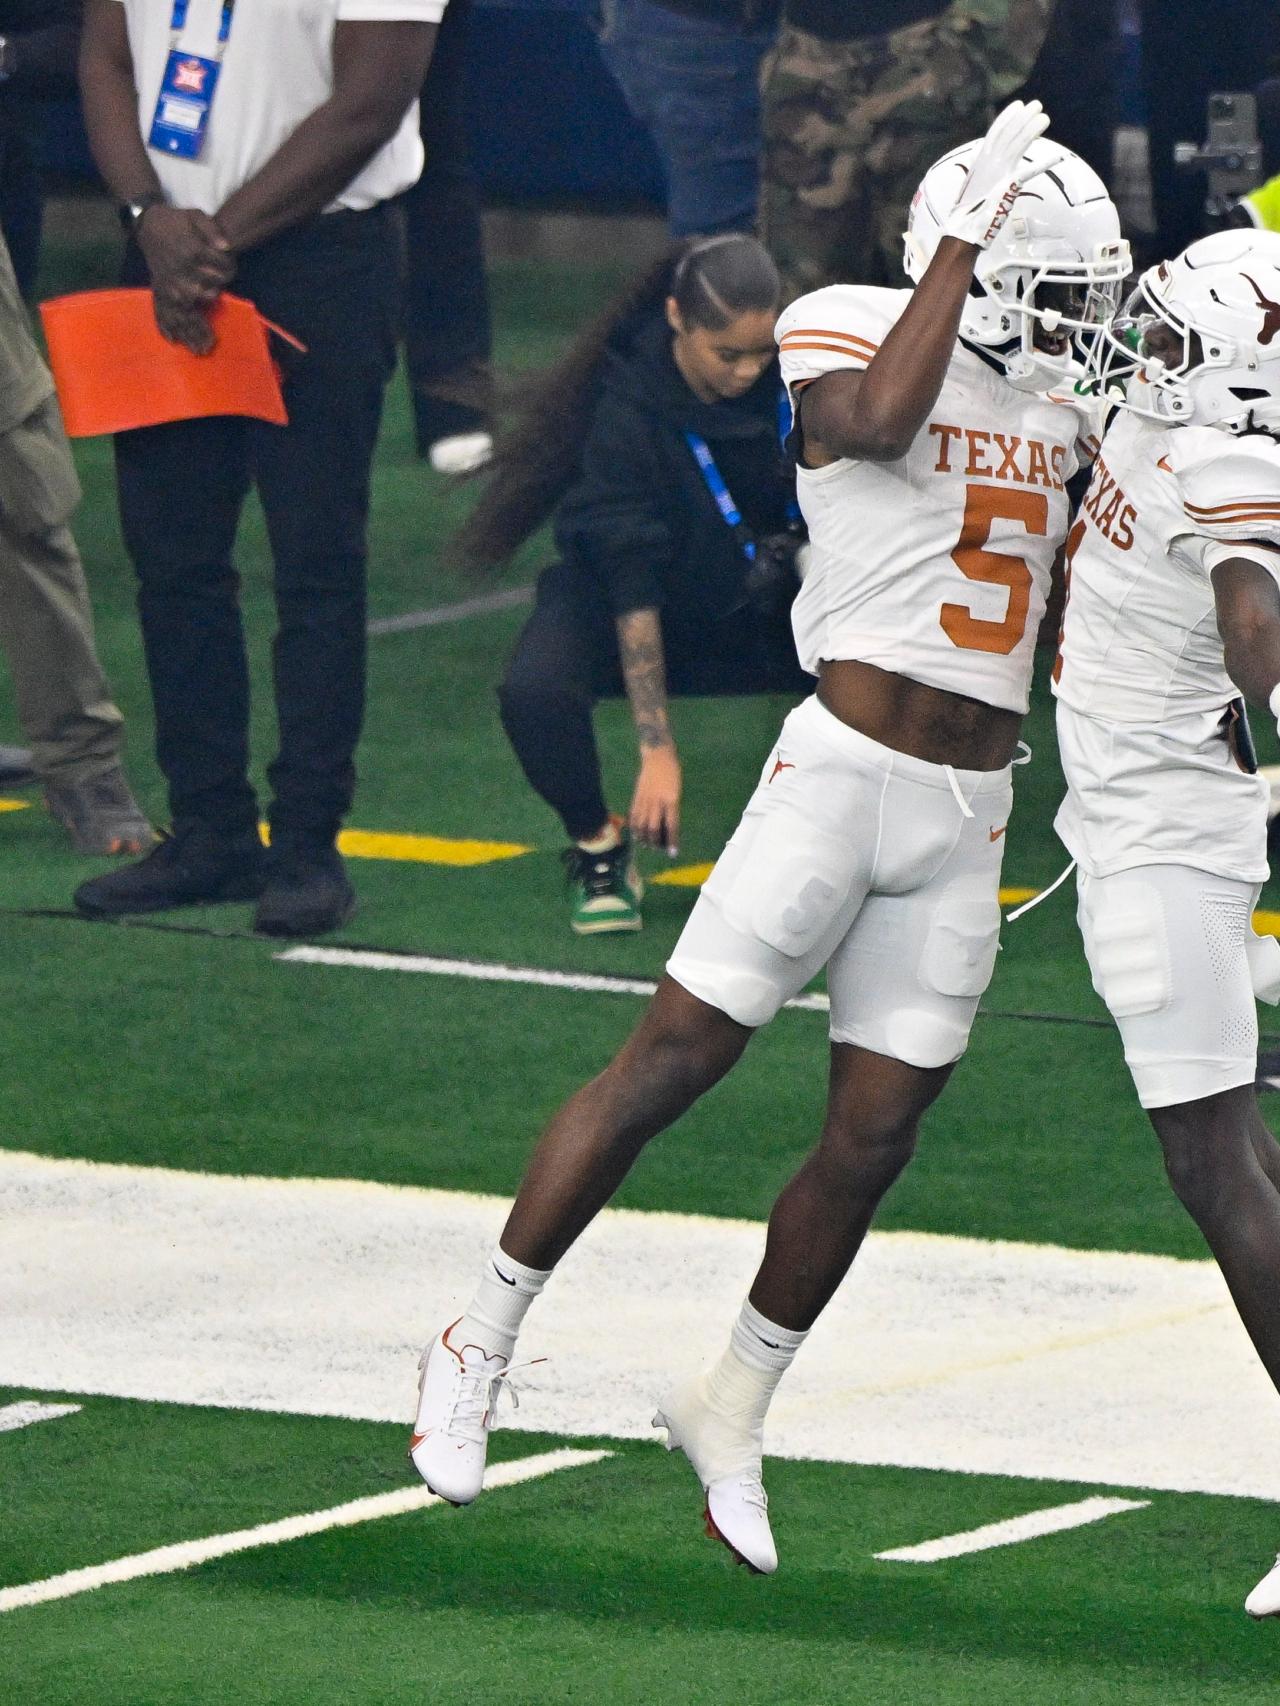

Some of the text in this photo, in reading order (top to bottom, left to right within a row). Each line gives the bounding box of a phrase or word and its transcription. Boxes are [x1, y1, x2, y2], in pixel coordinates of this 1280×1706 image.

[984, 181, 1022, 240] TEXAS
[929, 423, 1067, 492] TEXAS
[939, 483, 1050, 656] 5
